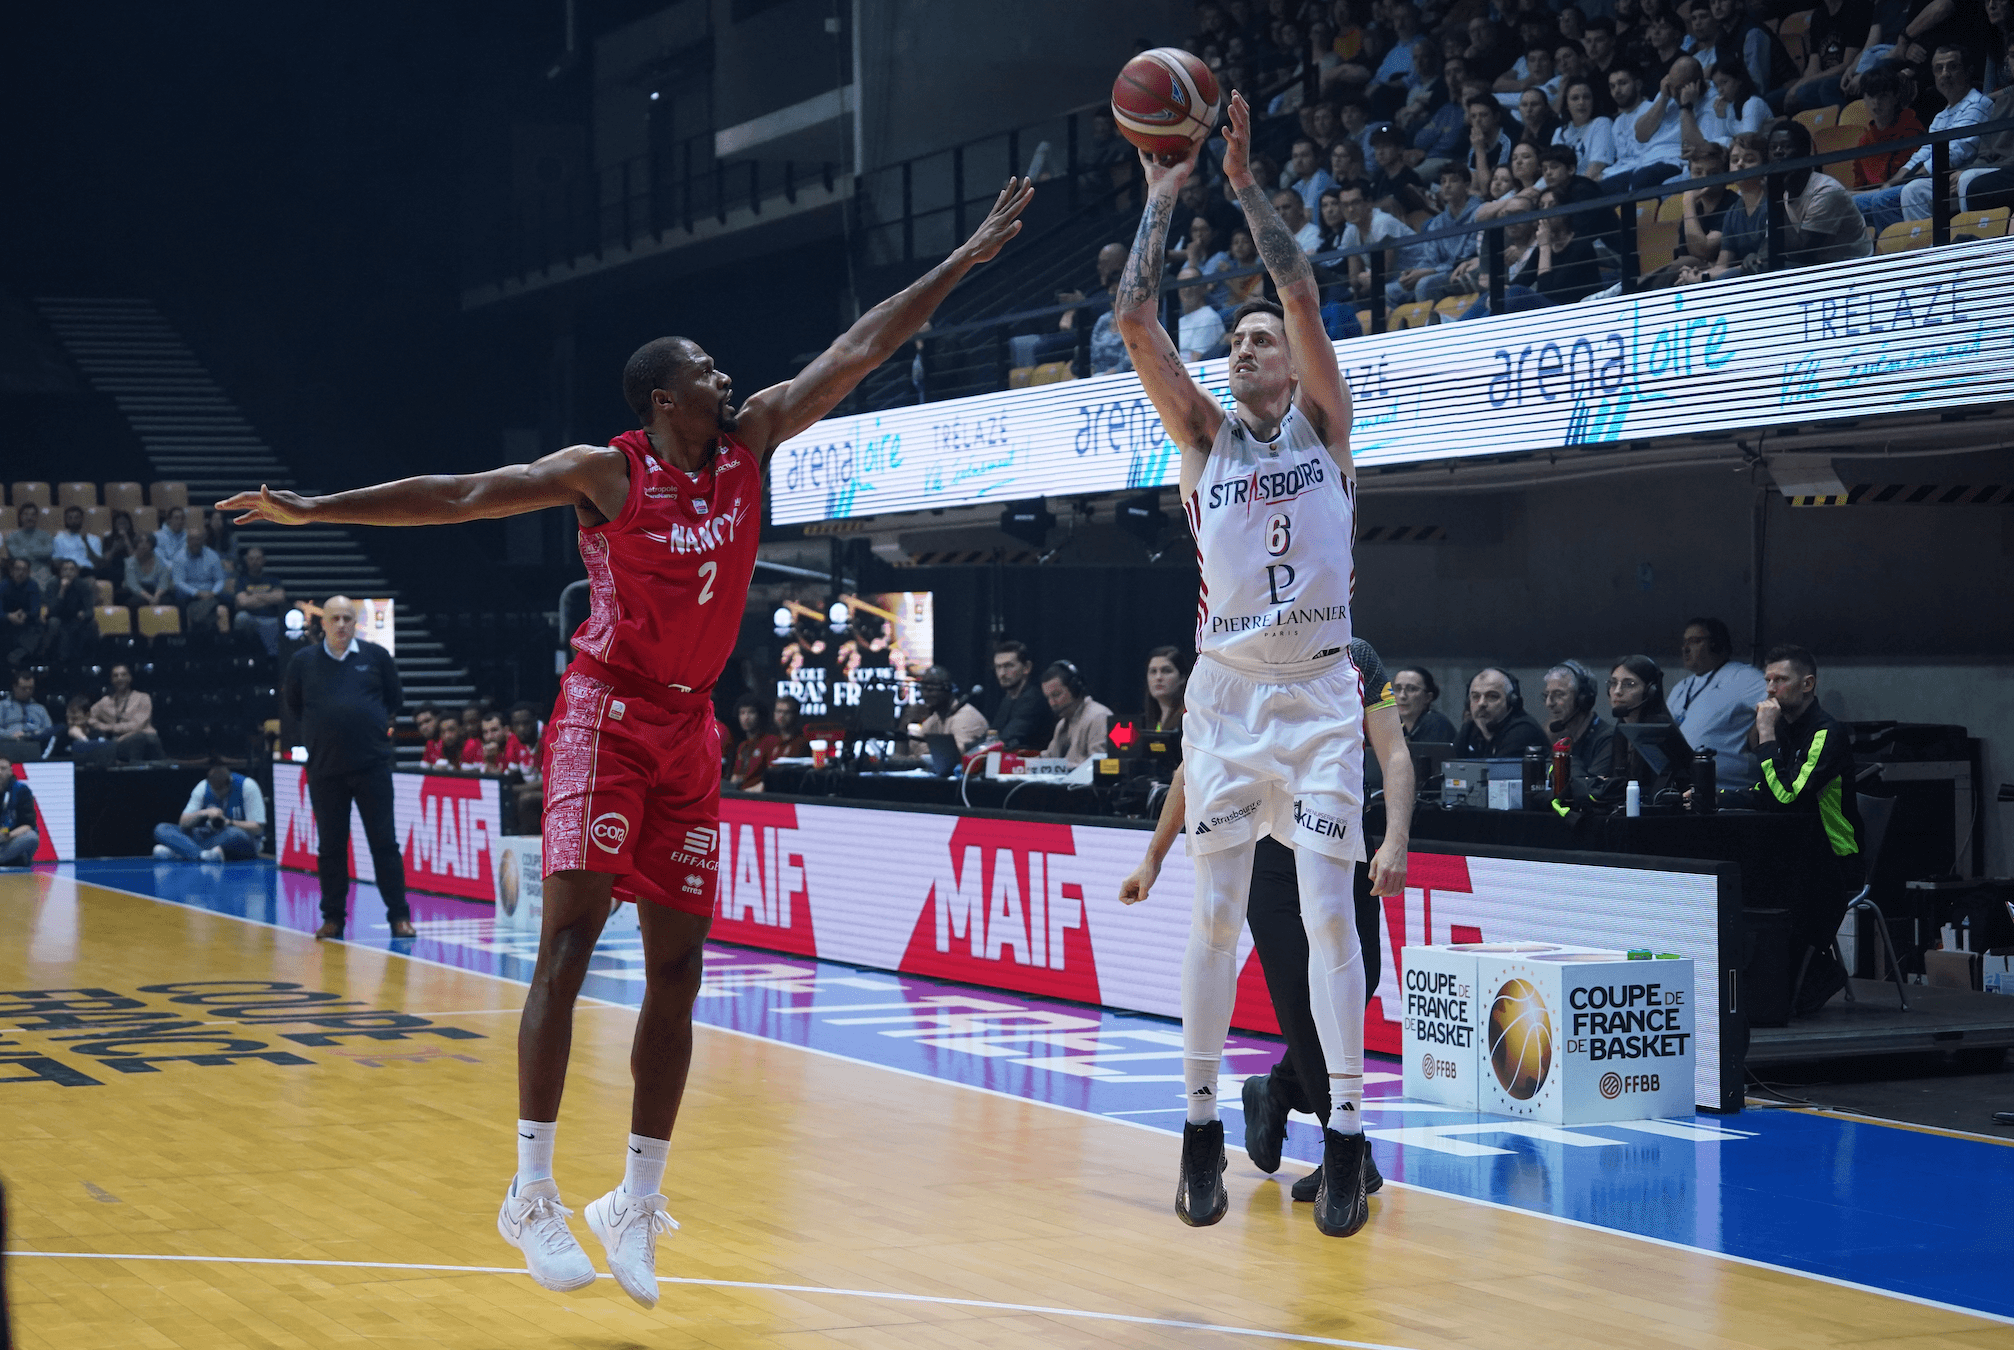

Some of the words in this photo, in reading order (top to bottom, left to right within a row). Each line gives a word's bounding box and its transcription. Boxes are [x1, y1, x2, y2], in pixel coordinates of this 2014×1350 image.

[1210, 458, 1324, 513] STRASBOURG
[670, 508, 738, 555] NANCY
[1265, 513, 1291, 556] 6
[698, 562, 717, 605] 2
[1212, 614, 1272, 633] PIERRE
[1277, 605, 1347, 626] LANNIER
[411, 795, 487, 880] MAIF
[594, 824, 625, 841] cora
[1299, 812, 1347, 840] KLEIN
[670, 851, 719, 871] EIFFAGE
[935, 845, 1082, 971] MAIF
[1406, 969, 1457, 996] COUPE
[1458, 984, 1471, 999] DE
[1569, 983, 1662, 1010] COUPE
[1665, 991, 1685, 1005] DE
[137, 981, 488, 1047] COUPE
[1408, 994, 1468, 1023] FRANCE
[1573, 1008, 1681, 1036] FRANCE
[1404, 1017, 1416, 1032] DE
[1417, 1019, 1474, 1049] BASKET
[1567, 1038, 1588, 1054] DE
[1590, 1033, 1691, 1061] BASKET
[1436, 1059, 1457, 1080] FFBB
[1624, 1074, 1660, 1094] FFBB
